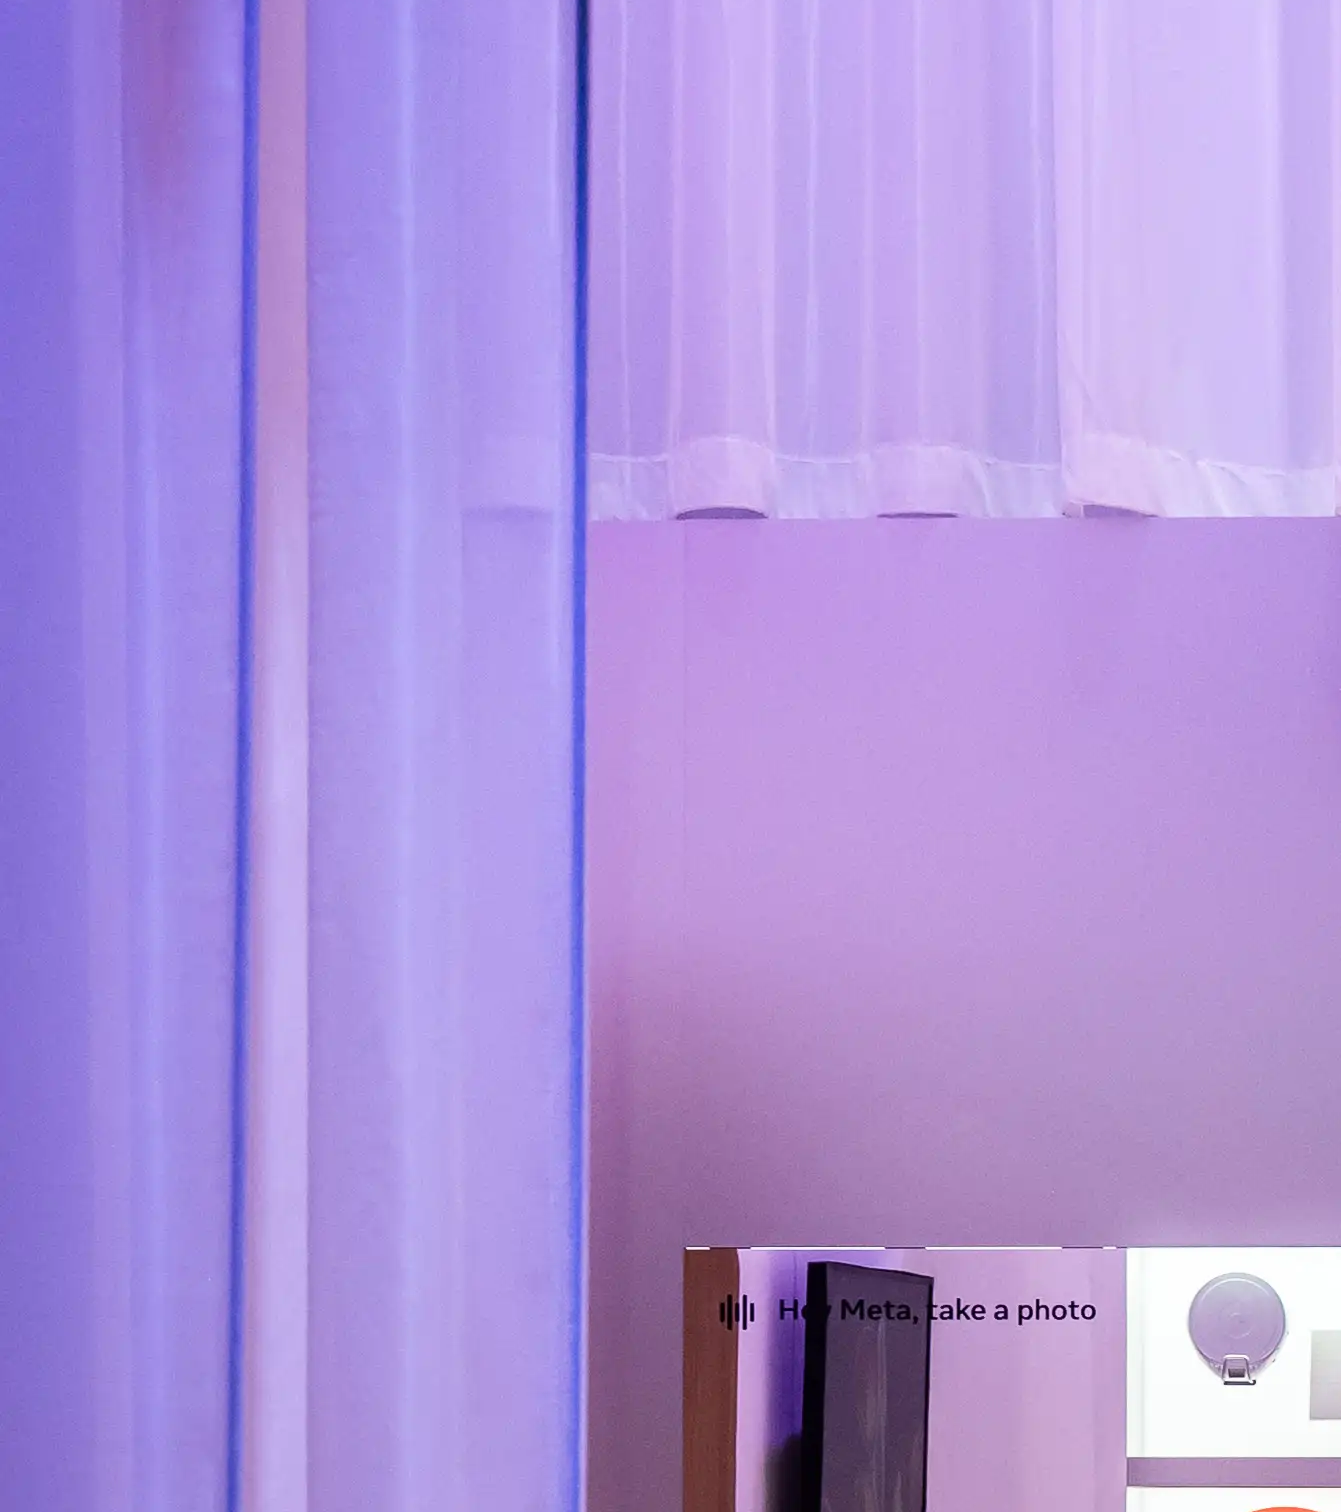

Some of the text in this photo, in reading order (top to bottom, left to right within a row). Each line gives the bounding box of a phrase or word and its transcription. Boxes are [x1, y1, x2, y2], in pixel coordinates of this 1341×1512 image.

[841, 1298, 919, 1324] Meta,
[928, 1298, 986, 1321] take
[994, 1303, 1009, 1321] a
[1018, 1298, 1096, 1325] photo
